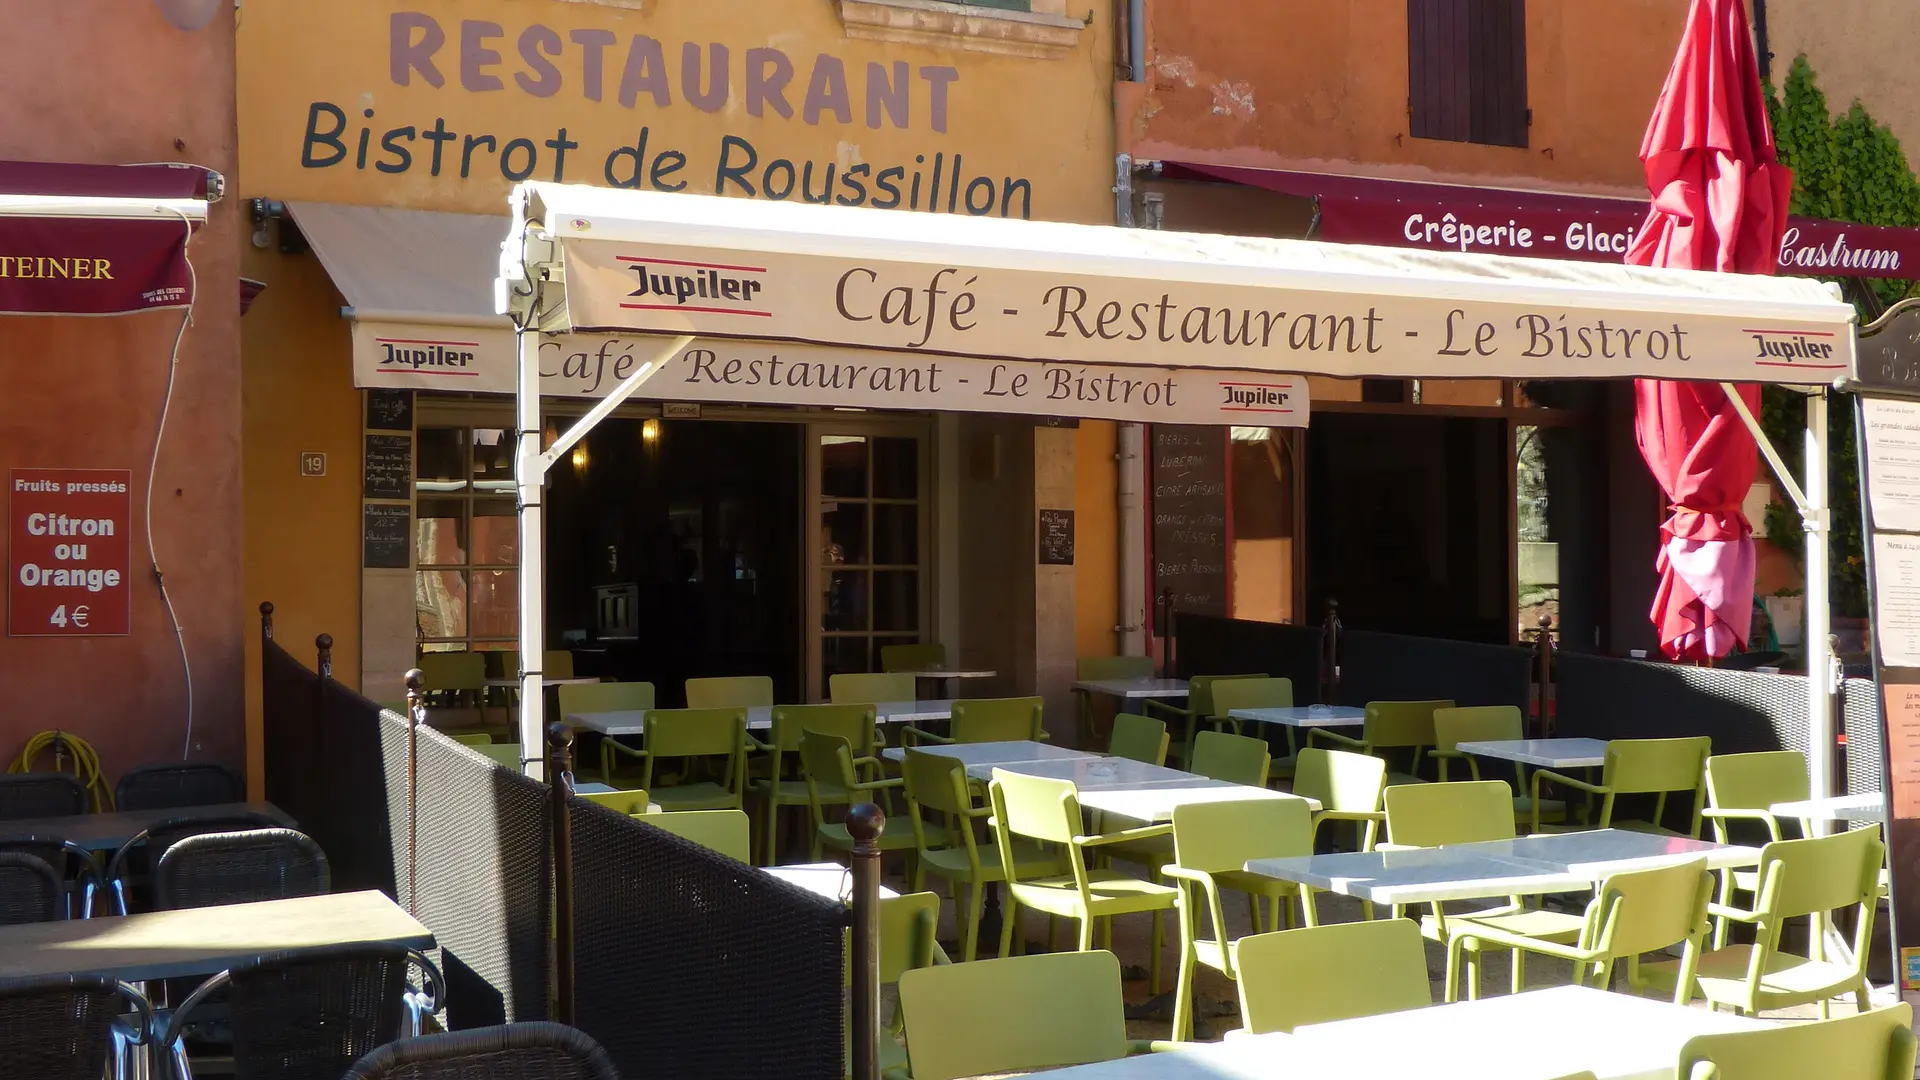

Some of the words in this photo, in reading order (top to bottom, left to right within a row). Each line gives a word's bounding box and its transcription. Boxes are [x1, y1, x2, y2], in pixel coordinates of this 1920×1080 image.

[390, 12, 959, 134] RESTAURANT
[301, 102, 578, 182] Bistrot
[604, 127, 687, 192] de
[716, 135, 1030, 220] Roussillon
[1404, 212, 1533, 252] Crêperie
[1777, 227, 1901, 270] Castrum
[627, 265, 761, 304] Jupiler
[835, 267, 978, 347] Café
[1042, 285, 1384, 354] Restaurant
[1437, 308, 1498, 356] Le
[1516, 313, 1692, 362] Bistrot
[380, 343, 474, 369] Jupiler
[1752, 335, 1833, 362] Jupiler
[538, 339, 634, 393] Café
[683, 349, 942, 393] Restaurant
[983, 364, 1028, 397] Le
[1045, 368, 1177, 406] Bistrot
[1223, 386, 1289, 408] Jupiler
[305, 457, 322, 472] 19
[15, 479, 60, 493] Fruits
[67, 480, 126, 494] pressés
[27, 512, 114, 537] Citron
[54, 543, 87, 560] ou
[20, 563, 120, 592] Orange
